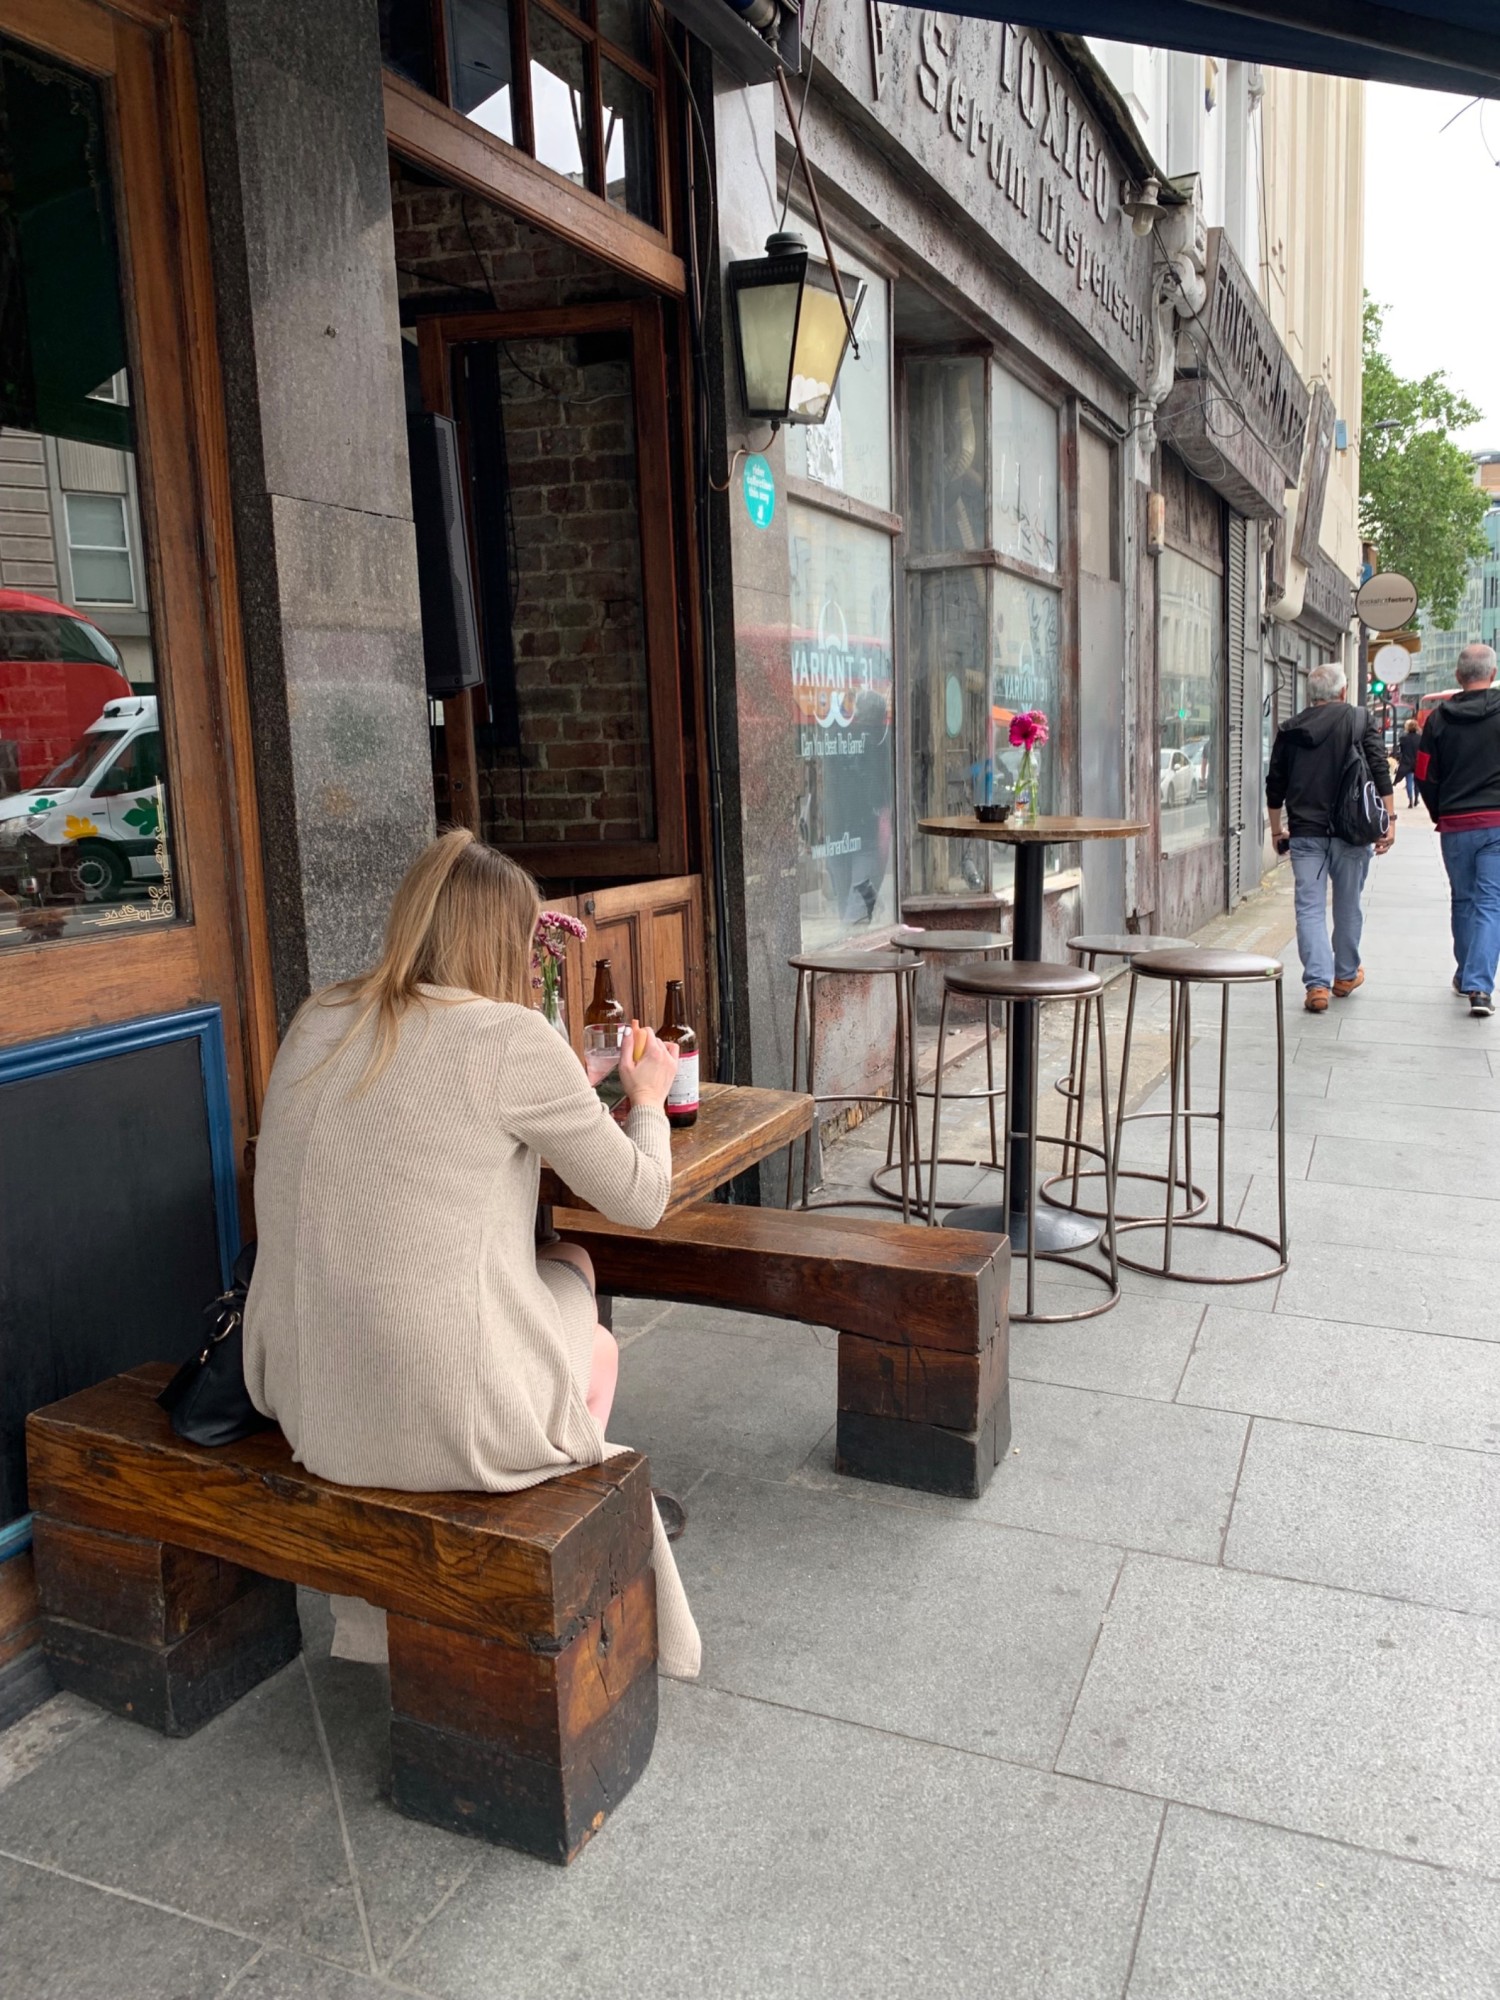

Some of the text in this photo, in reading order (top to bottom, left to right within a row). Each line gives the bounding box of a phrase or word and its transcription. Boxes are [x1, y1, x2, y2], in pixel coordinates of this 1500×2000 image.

[792, 651, 873, 694] VARIANT 31
[1004, 674, 1038, 701] VARIANT
